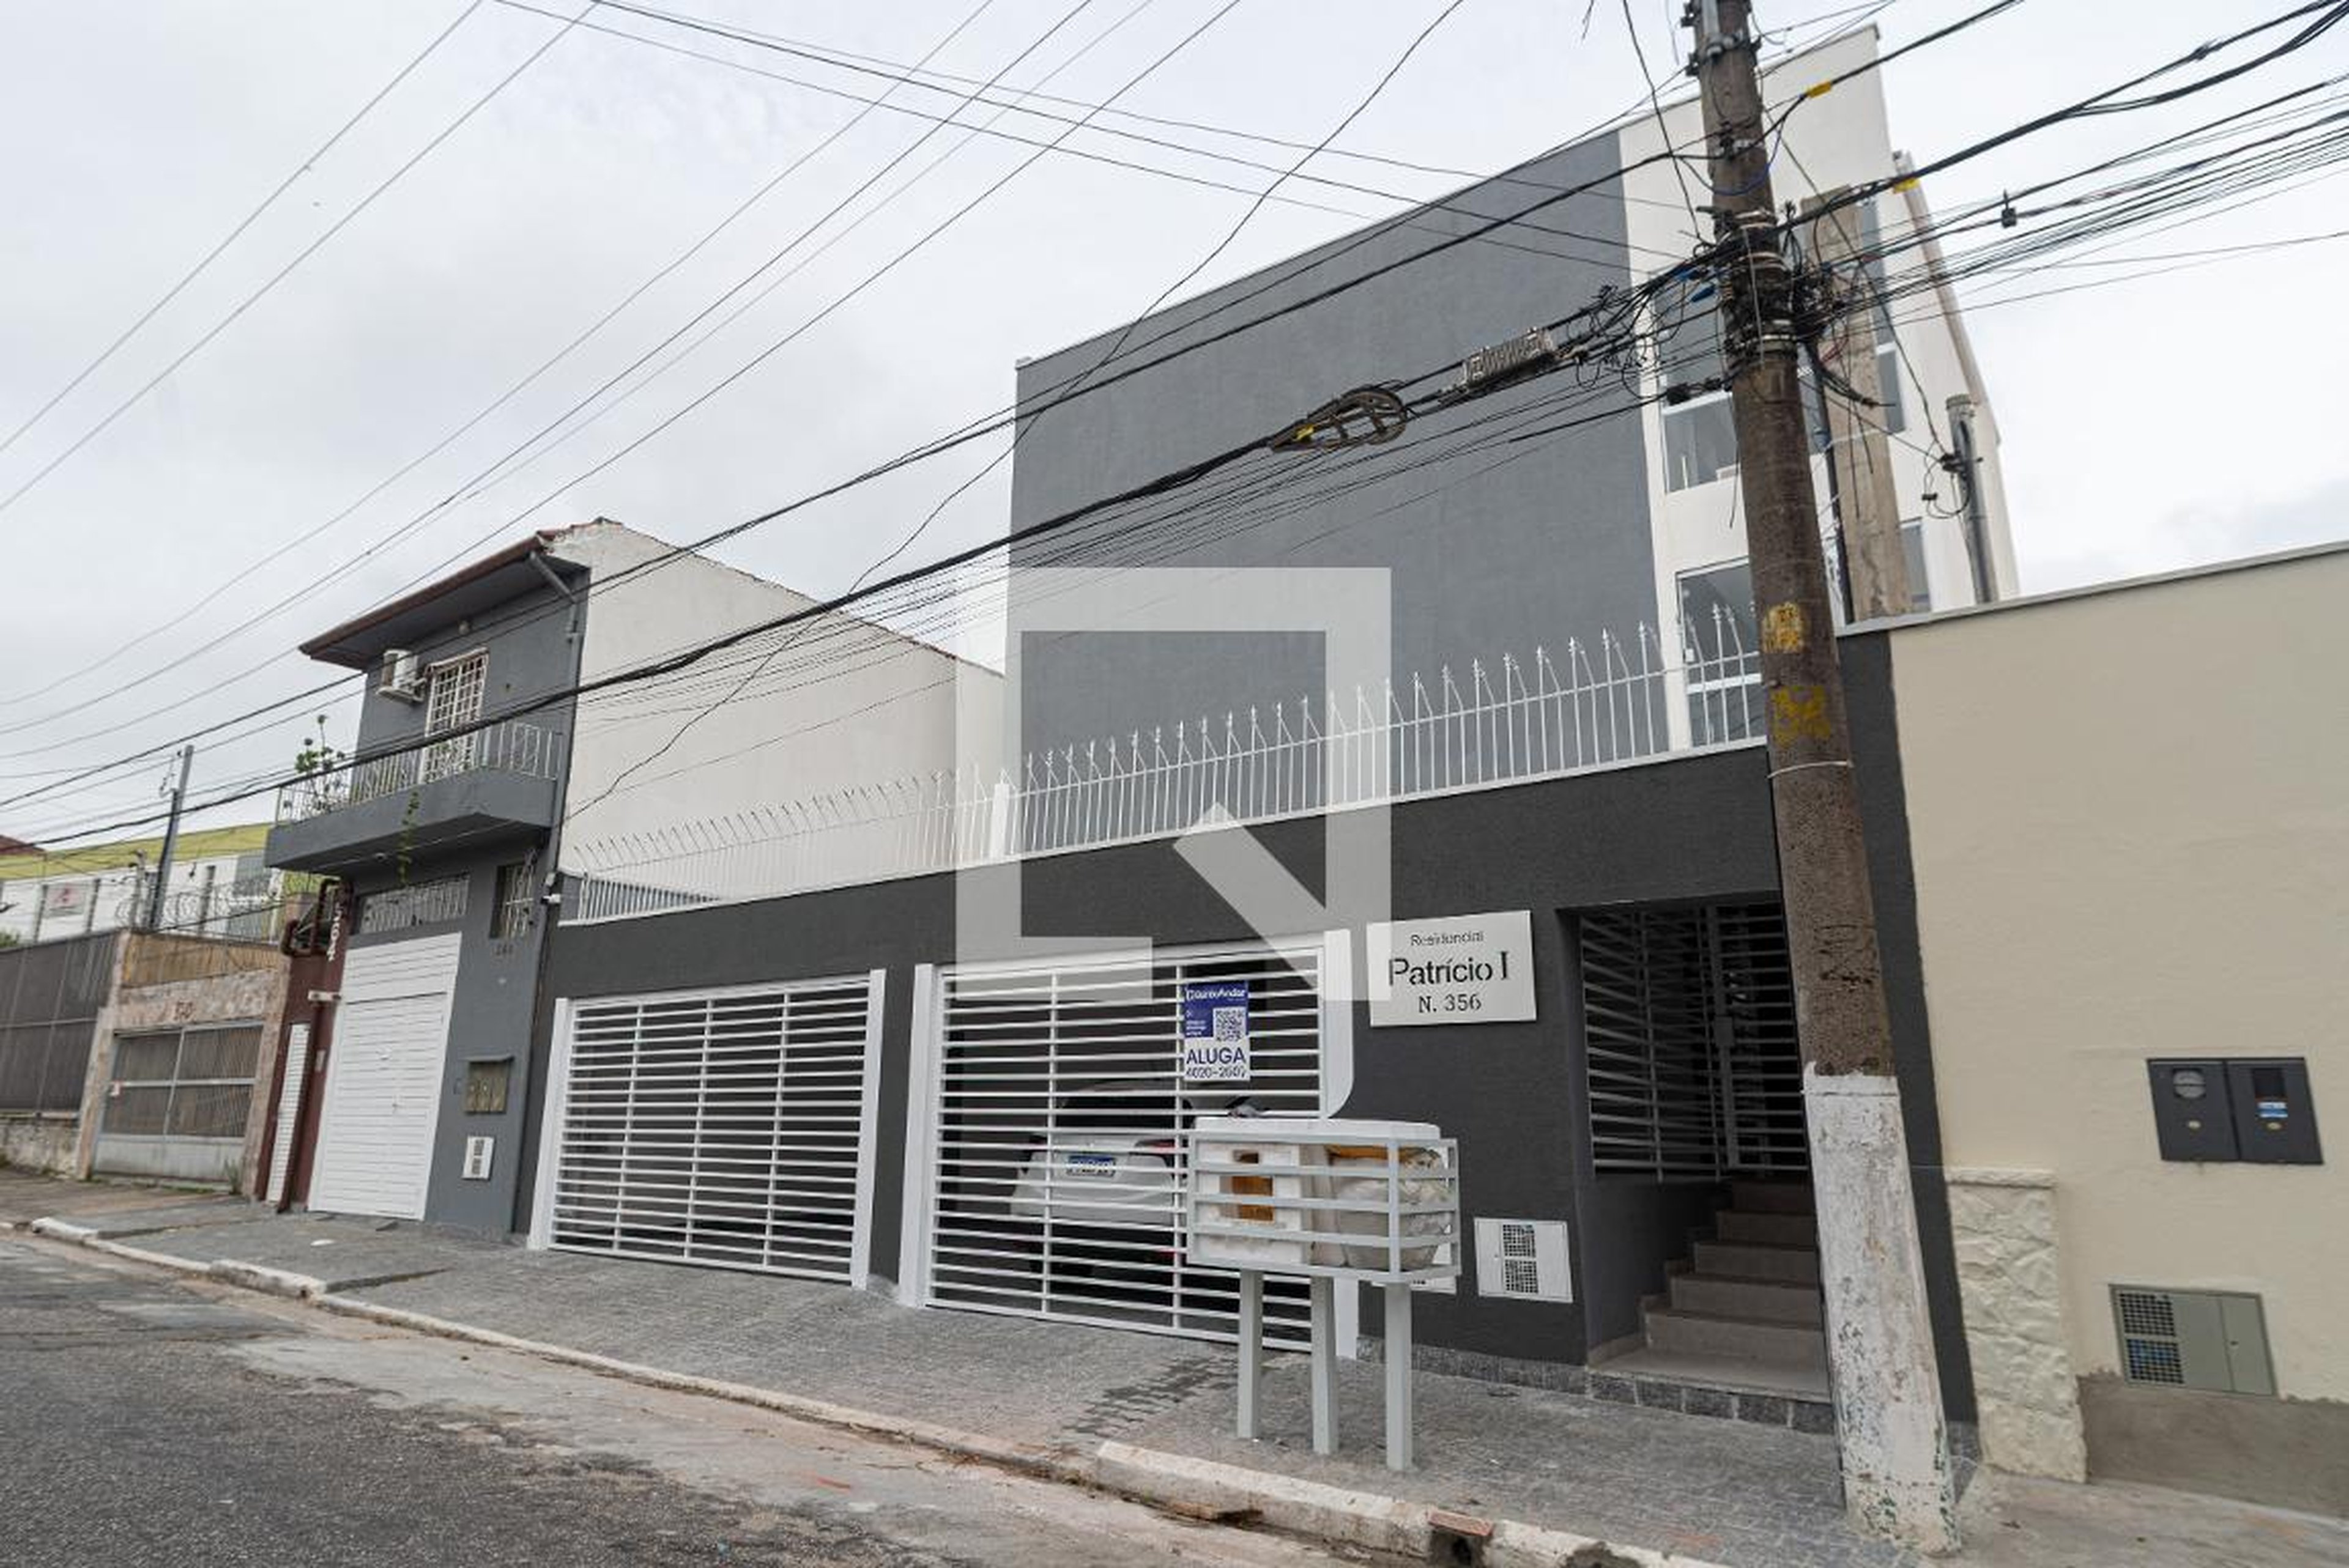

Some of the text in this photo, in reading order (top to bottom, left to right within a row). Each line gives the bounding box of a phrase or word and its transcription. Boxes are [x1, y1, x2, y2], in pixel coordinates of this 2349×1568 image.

[1410, 931, 1484, 947] Residencial
[1389, 951, 1508, 986] Patrício I
[1419, 993, 1482, 1013] N. 356
[1186, 1047, 1246, 1064] ALUGA
